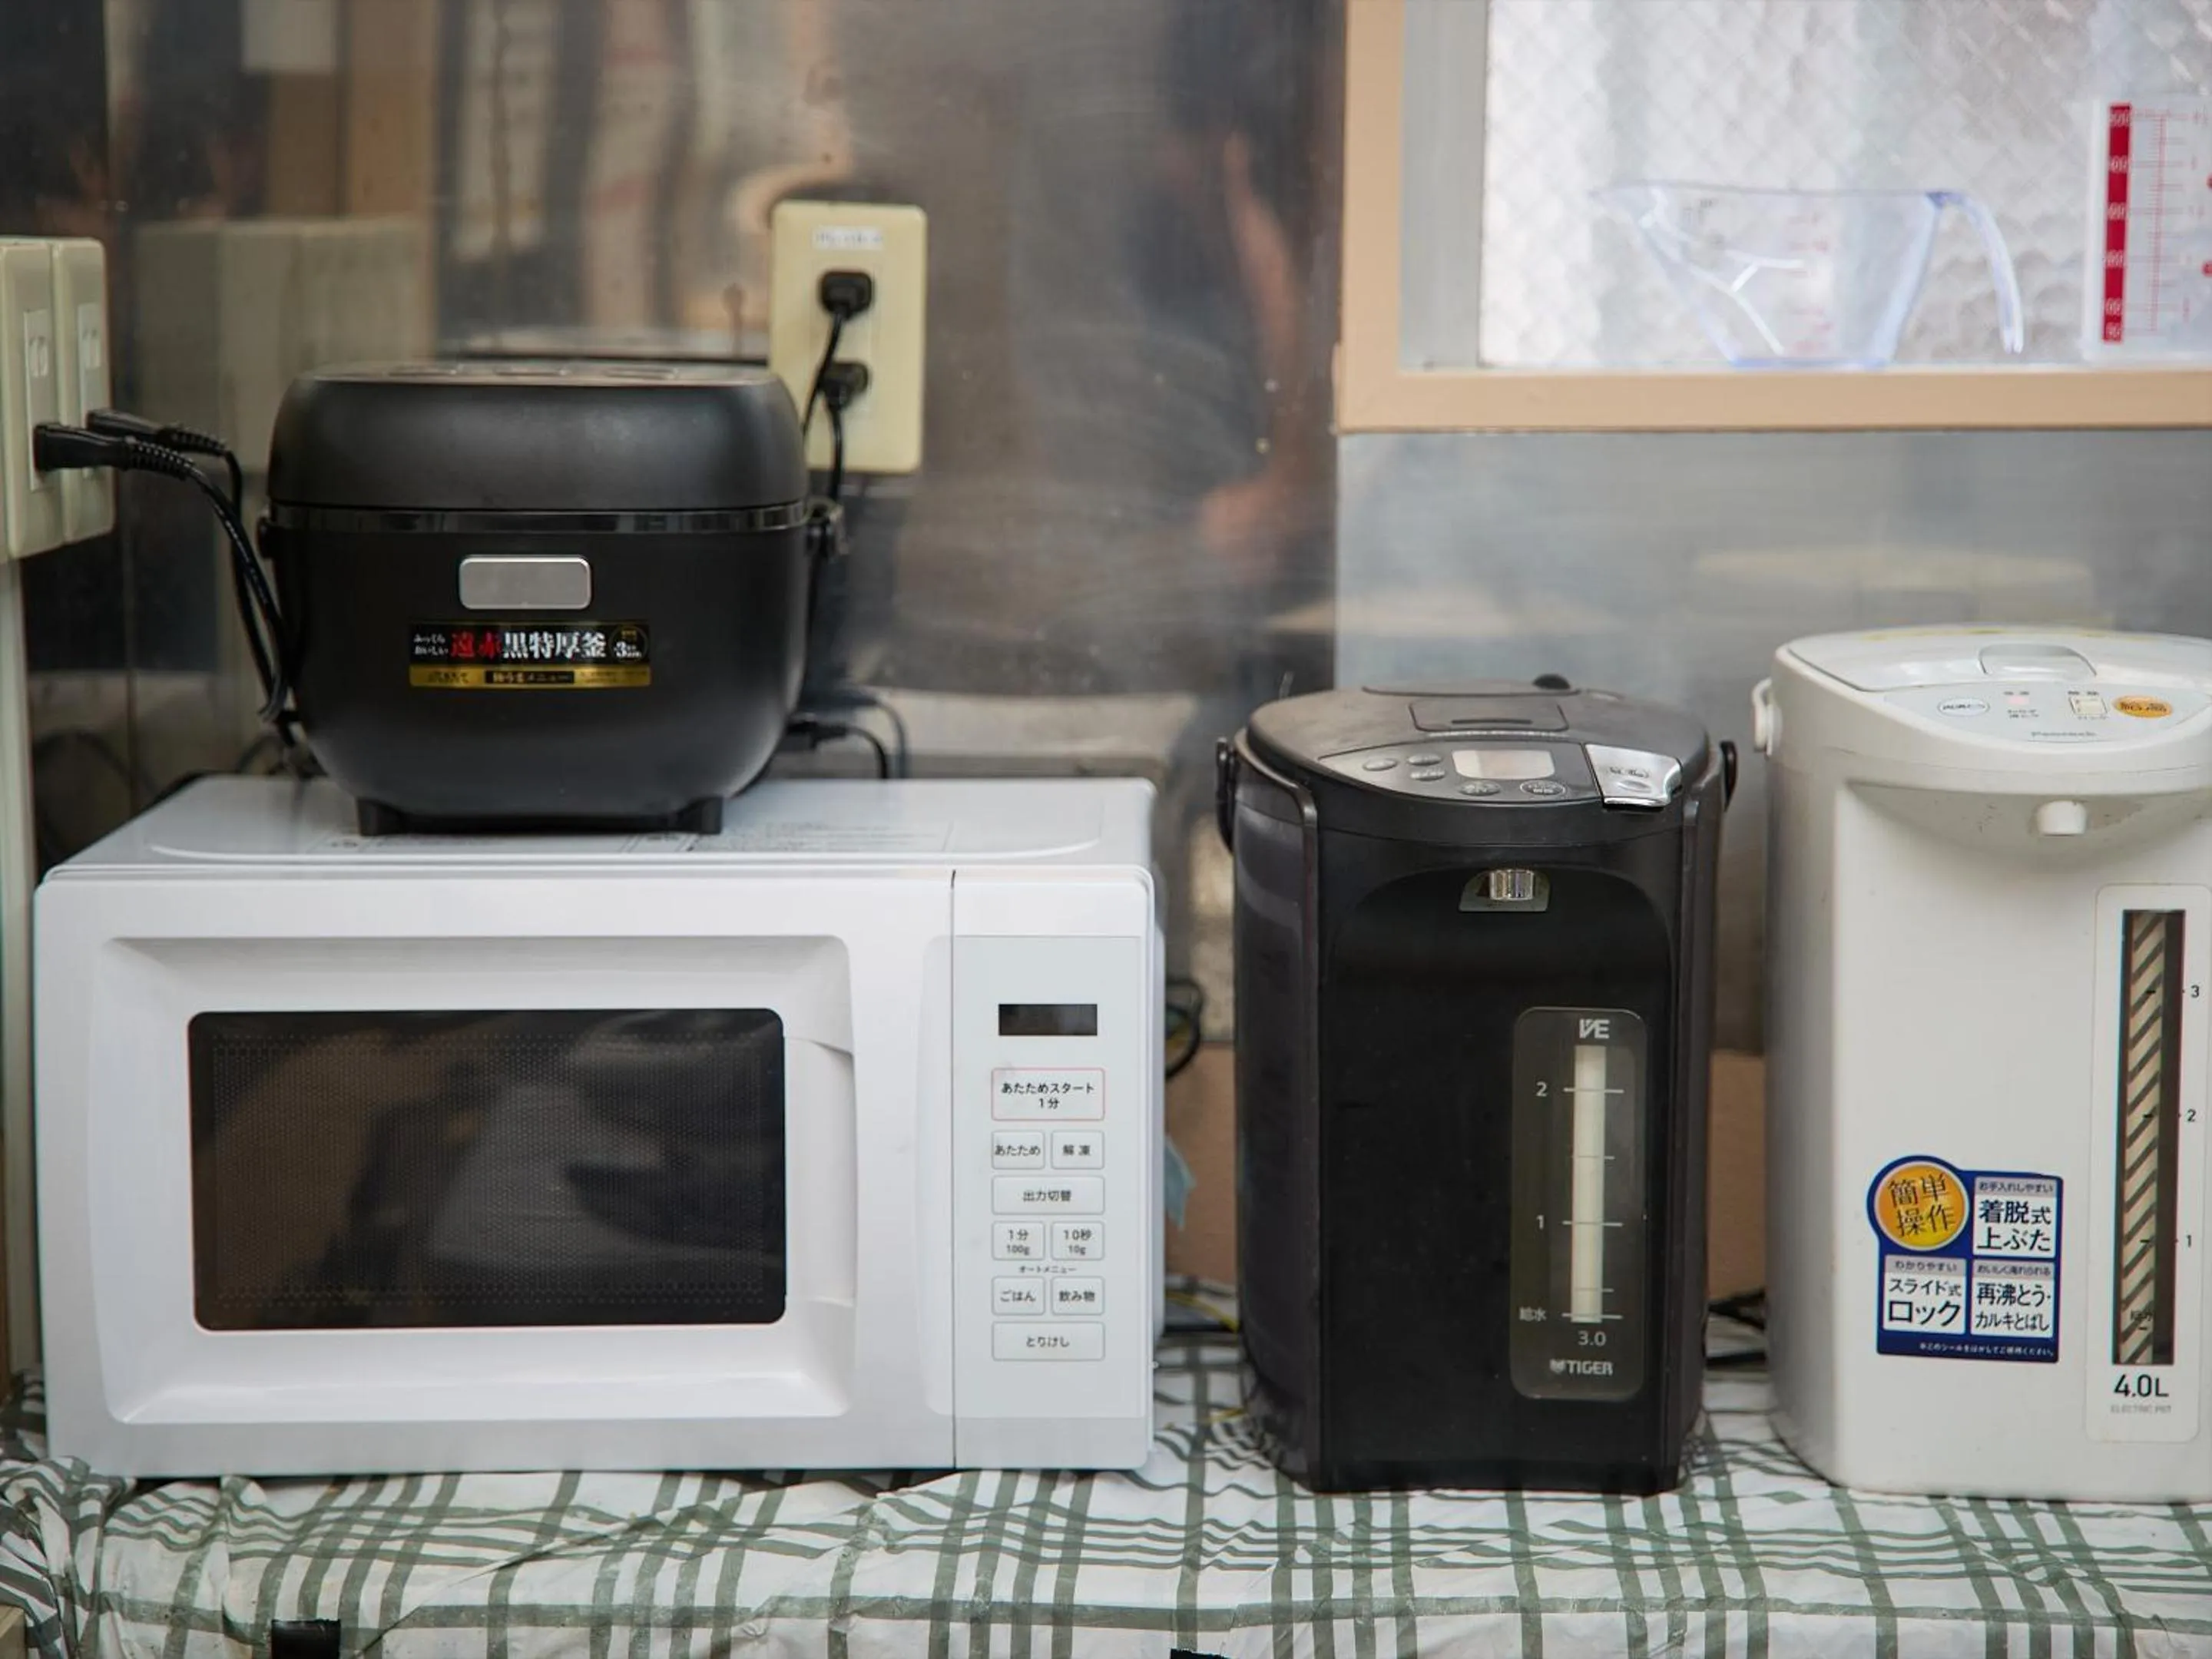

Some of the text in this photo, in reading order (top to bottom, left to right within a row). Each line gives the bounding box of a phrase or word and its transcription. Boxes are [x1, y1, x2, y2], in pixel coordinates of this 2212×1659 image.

[2190, 985, 2200, 998] 3
[1002, 1082, 1094, 1094] あたためスタート
[1536, 1081, 1548, 1097] 2
[1038, 1098, 1059, 1109] 1分
[2187, 1109, 2197, 1122] 2
[995, 1144, 1041, 1157] あたため
[1023, 1190, 1071, 1202] 出力切替
[1888, 1173, 1947, 1208] 簡単
[1979, 1199, 2051, 1225] 着脱式
[1537, 1215, 1545, 1229] 1
[1896, 1204, 1957, 1237] 操作
[1008, 1229, 1029, 1240] 1分
[1063, 1229, 1091, 1240] 10秒
[1976, 1227, 2051, 1252] 上ぶた
[2187, 1234, 2192, 1247] 1
[1006, 1245, 1031, 1256] 100g
[1068, 1245, 1086, 1256] 10g
[1889, 1278, 1962, 1296] スライド式
[999, 1289, 1036, 1302] ごはん
[1058, 1290, 1095, 1303] 飲み物
[1889, 1300, 1961, 1326] ロック
[1975, 1311, 2049, 1332] カルキとばし
[1026, 1336, 1070, 1348] とりけし
[1578, 1330, 1607, 1346] 3.0
[1566, 1359, 1614, 1376] TIGER
[2113, 1373, 2170, 1397] 4.0L
